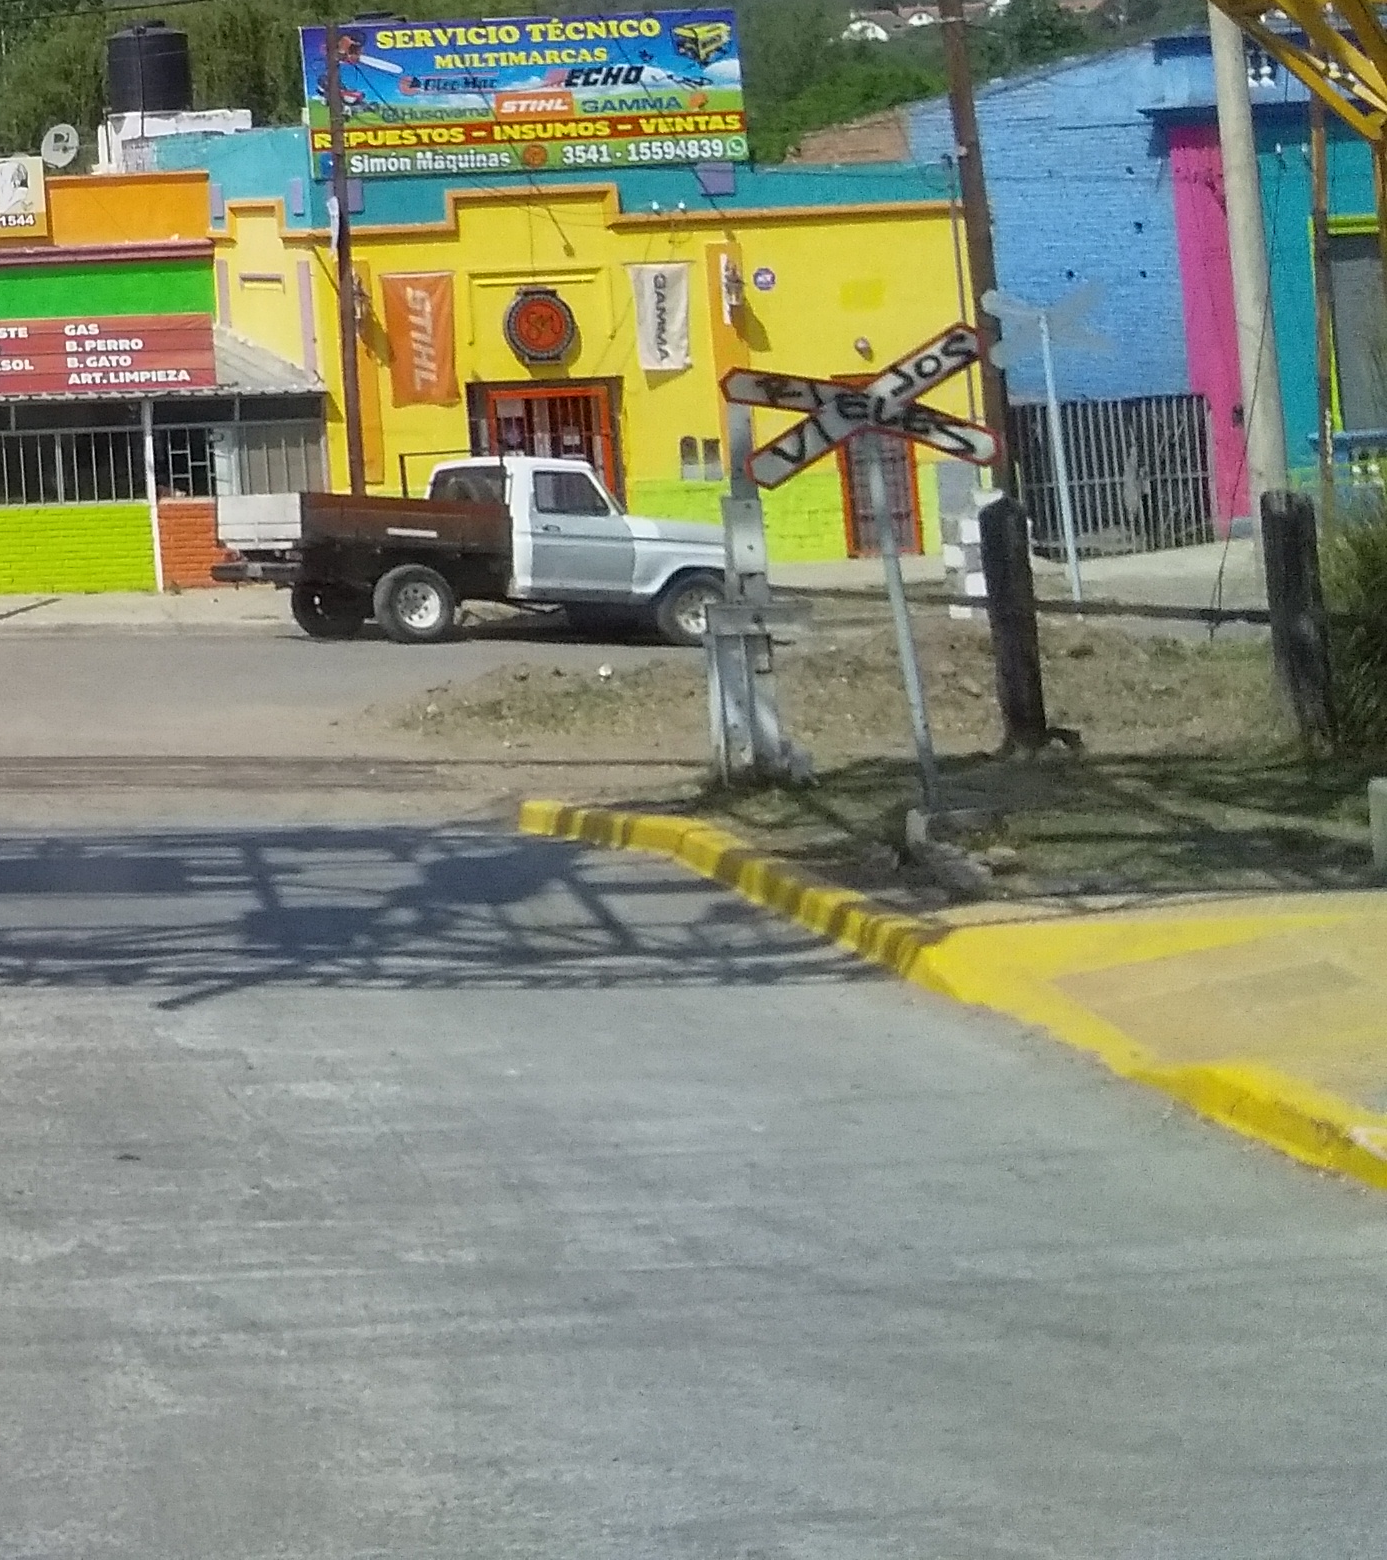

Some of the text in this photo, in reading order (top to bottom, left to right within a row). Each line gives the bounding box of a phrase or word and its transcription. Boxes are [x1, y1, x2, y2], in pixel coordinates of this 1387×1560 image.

[376, 18, 661, 49] SERVICIO TÉCNICO
[435, 47, 608, 69] MULTIMARCAS
[564, 65, 645, 87] ECHO
[500, 97, 568, 114] STIHL
[581, 96, 683, 113] GAMMA
[494, 121, 611, 141] INSUMOS
[639, 115, 741, 133] VENTAS
[350, 153, 411, 172] Simón
[562, 144, 611, 164] 3541
[651, 271, 671, 362] GAMMA
[64, 323, 100, 336] GAS
[405, 286, 439, 392] STIHL
